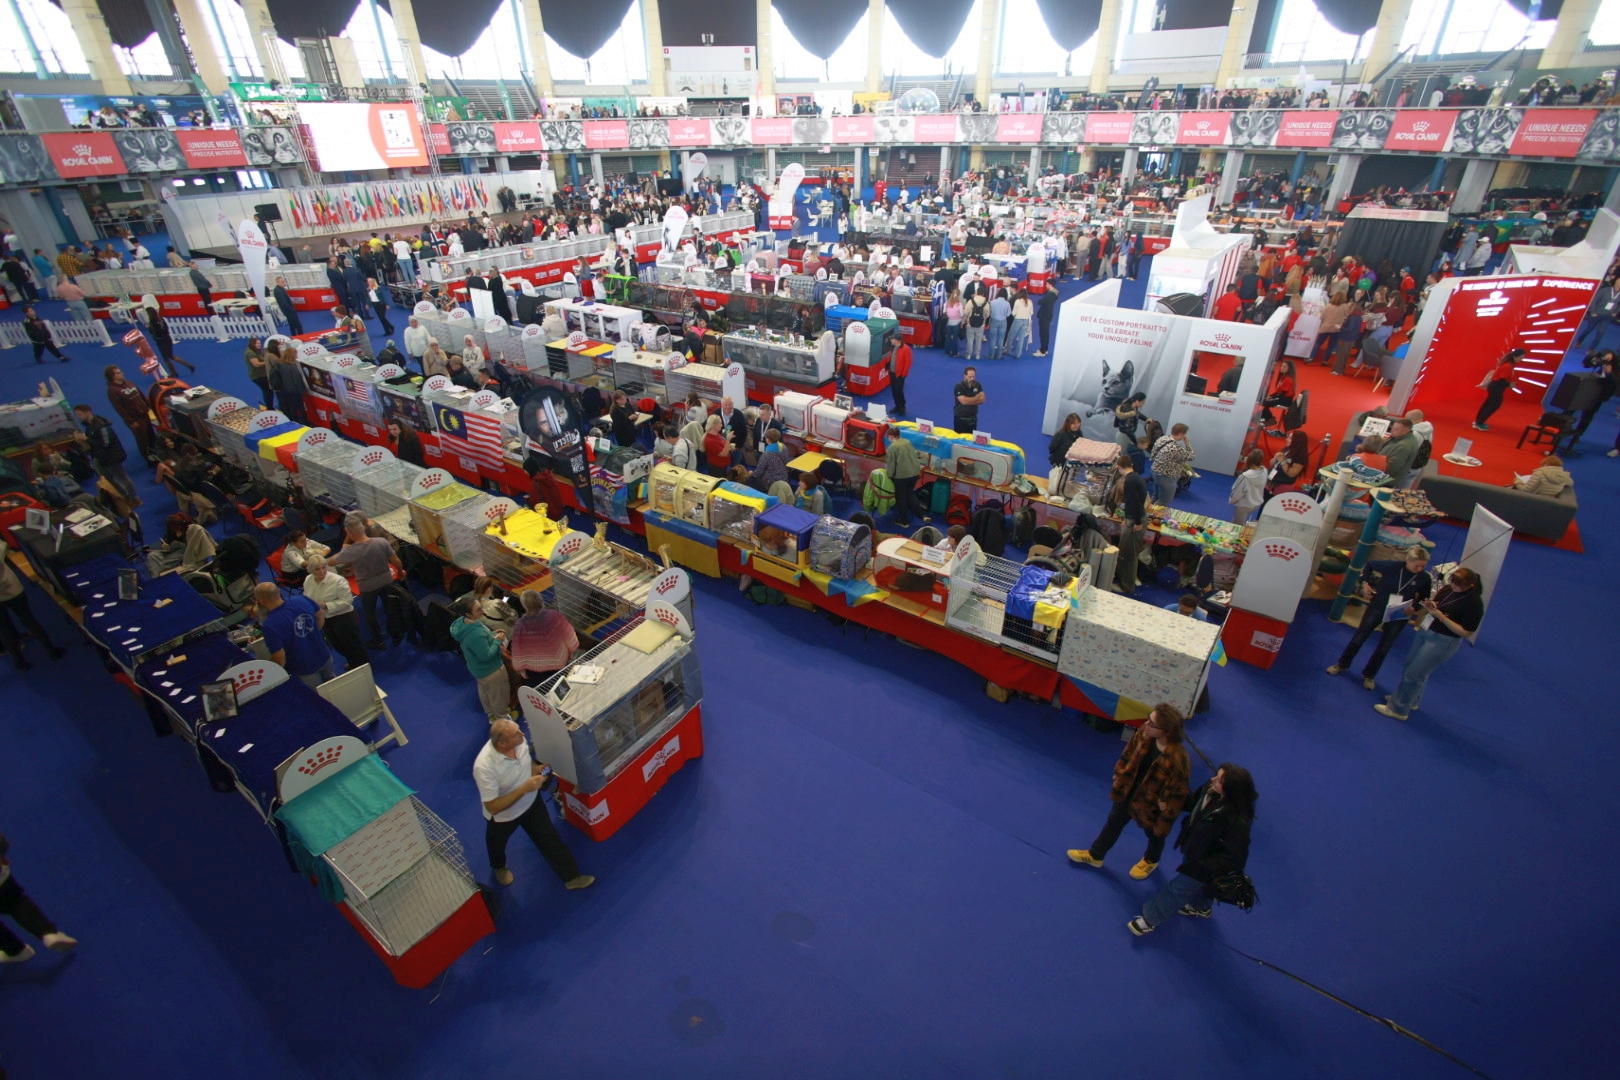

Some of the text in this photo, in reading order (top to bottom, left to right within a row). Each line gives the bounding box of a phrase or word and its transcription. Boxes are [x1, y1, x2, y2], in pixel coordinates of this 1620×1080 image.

[1559, 124, 1588, 133] NEEDS
[189, 140, 238, 150] UNIQUE NEEDS
[62, 156, 113, 167] ROYAL CANIN
[1542, 280, 1594, 290] EXPERIENCE
[1080, 315, 1091, 324] GET
[1098, 318, 1125, 326] CUSTOM
[1125, 321, 1158, 332] PORTRAIT
[1103, 326, 1140, 337] CELEBRATE
[1088, 332, 1154, 348] YOUR UNIQUE FELINE
[1199, 340, 1243, 351] ROYAL CANIN
